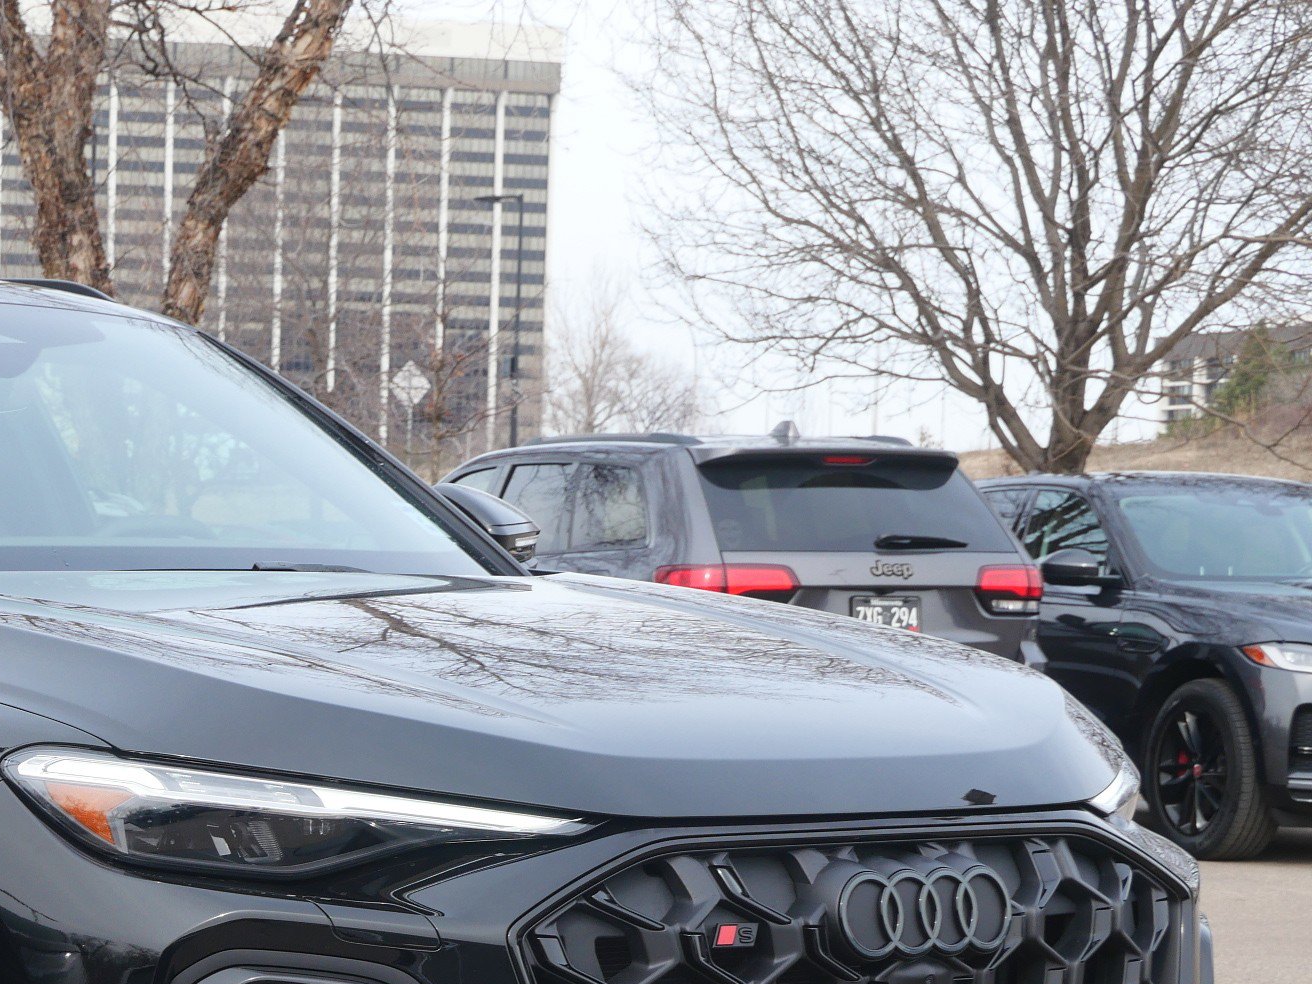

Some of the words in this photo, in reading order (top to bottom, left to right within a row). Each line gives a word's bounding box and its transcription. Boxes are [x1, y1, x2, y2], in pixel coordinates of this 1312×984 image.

[870, 559, 914, 580] Jeep
[891, 606, 918, 628] 294
[738, 926, 754, 944] S
